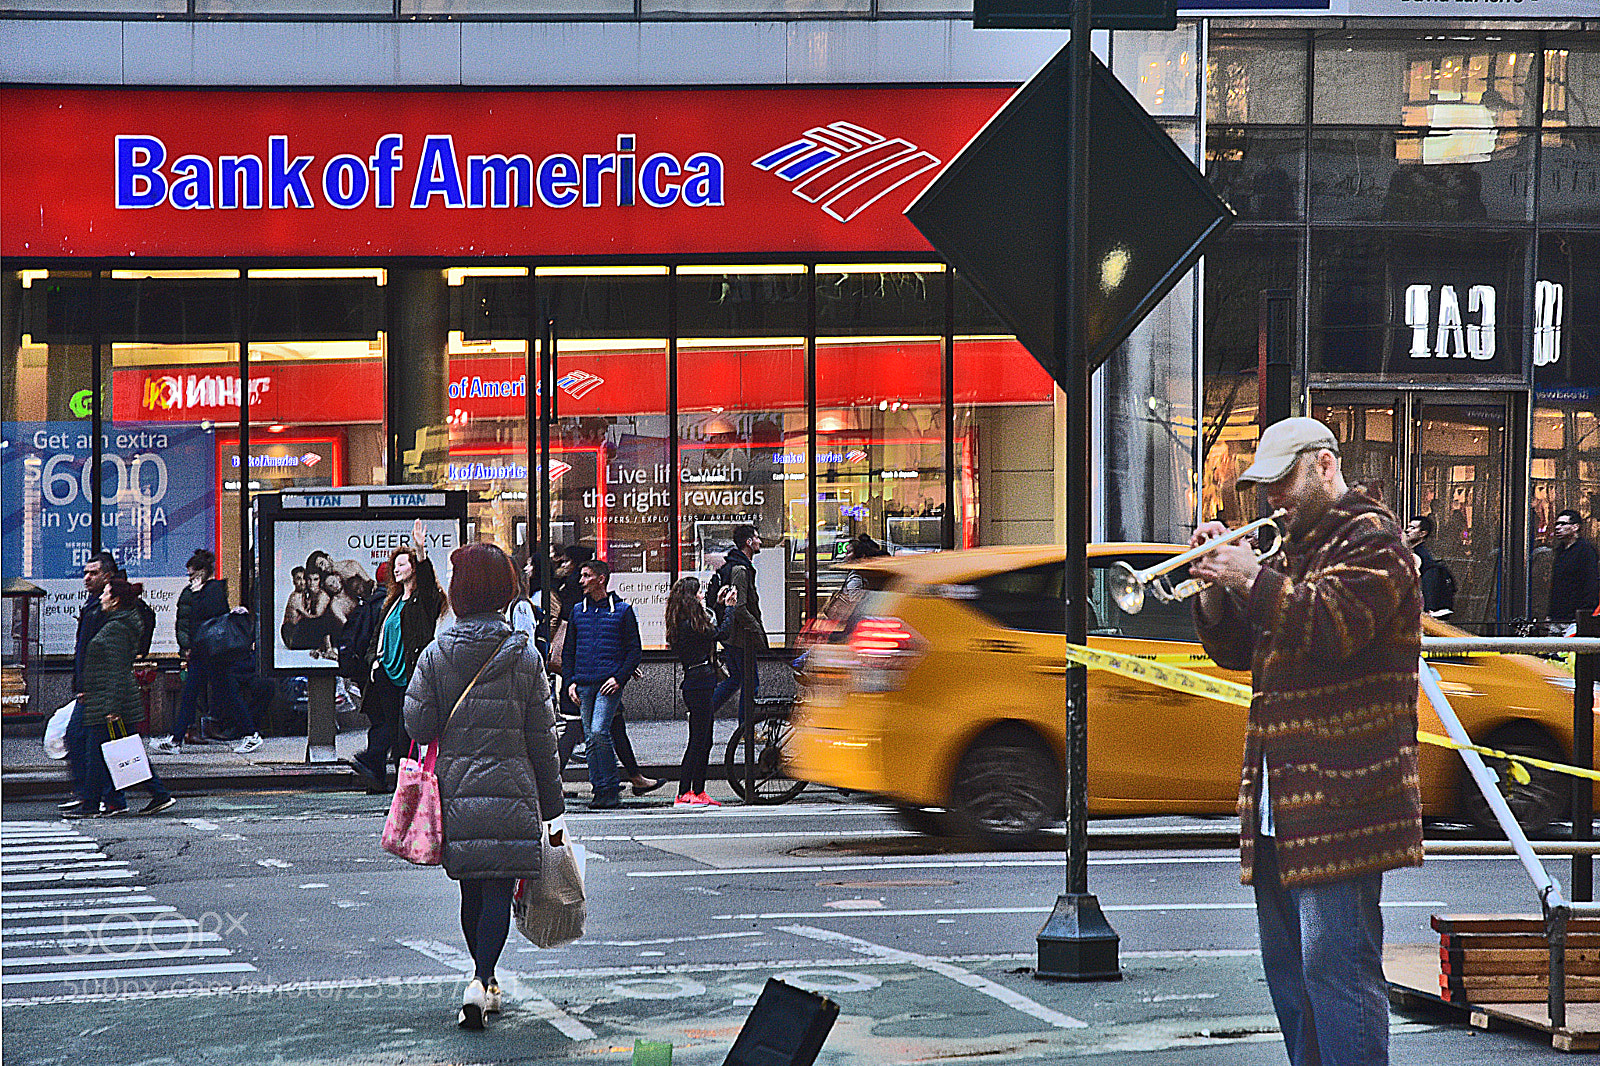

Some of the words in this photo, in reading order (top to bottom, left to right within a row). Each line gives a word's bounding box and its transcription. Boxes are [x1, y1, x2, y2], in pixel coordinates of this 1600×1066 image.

[115, 134, 314, 209] Bank
[323, 133, 402, 209] of
[409, 133, 725, 209] America
[448, 375, 468, 398] of
[469, 374, 542, 398] Ameria
[33, 431, 70, 449] Get
[77, 434, 109, 449] an
[116, 432, 168, 449] extra
[24, 452, 168, 506] $600
[606, 463, 647, 484] Live
[655, 462, 690, 484] life
[699, 462, 742, 482] with
[303, 496, 341, 507] TITAN
[388, 494, 426, 505] TITAN
[582, 489, 615, 508] the
[623, 487, 671, 512] right
[684, 485, 764, 506] rewards
[42, 508, 60, 528] in
[68, 511, 123, 533] your
[132, 508, 167, 528] IRA
[584, 515, 630, 524] SHOPPERS
[347, 534, 410, 549] QUEER
[72, 548, 120, 566] EDE
[54, 592, 76, 603] your
[78, 591, 87, 601] IR
[150, 590, 174, 601] Edge
[619, 582, 634, 592] Get
[637, 582, 652, 592] the
[654, 582, 671, 596] righ
[632, 595, 648, 606] your
[651, 594, 668, 605] lifes
[45, 605, 60, 616] get
[64, 605, 76, 615] up
